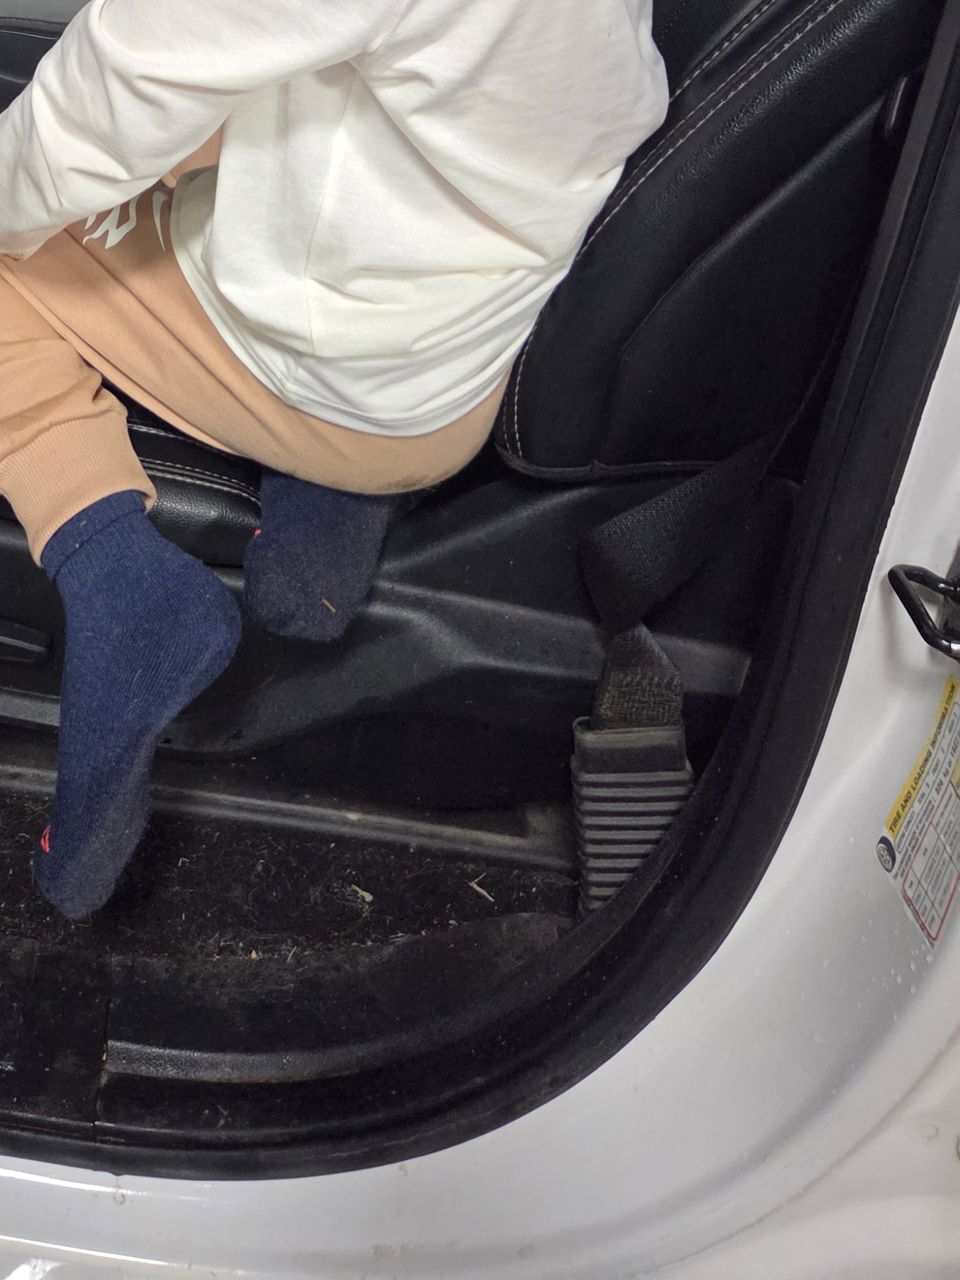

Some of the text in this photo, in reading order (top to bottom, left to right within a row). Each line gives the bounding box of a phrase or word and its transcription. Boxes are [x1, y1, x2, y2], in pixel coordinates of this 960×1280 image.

[889, 809, 902, 833] TIRE
[900, 790, 912, 812] AND
[911, 749, 932, 790] LOADING
[930, 682, 956, 749] INFORMATION
